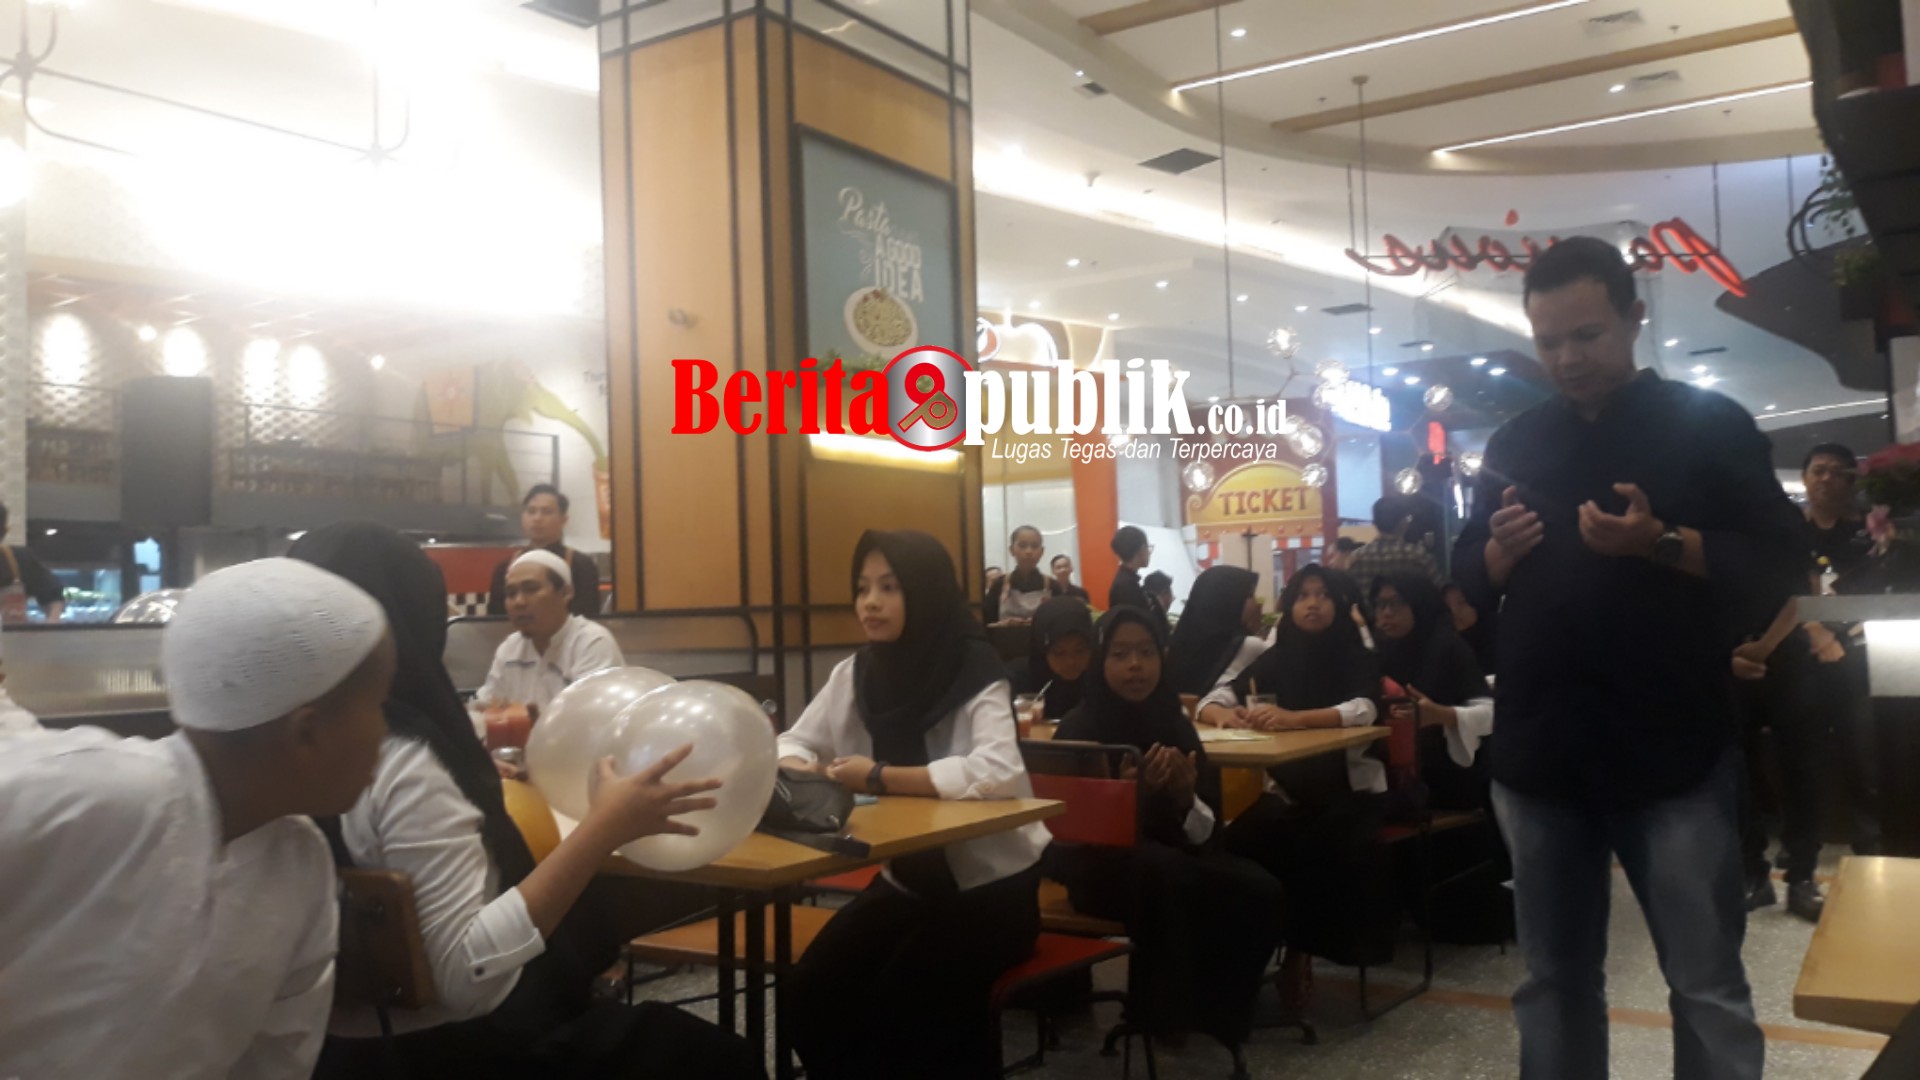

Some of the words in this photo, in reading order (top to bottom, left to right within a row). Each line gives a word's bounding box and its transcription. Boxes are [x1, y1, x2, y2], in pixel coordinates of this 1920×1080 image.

[838, 186, 892, 236] Pasta
[875, 257, 924, 303] IDEA
[1218, 487, 1309, 516] TICKET
